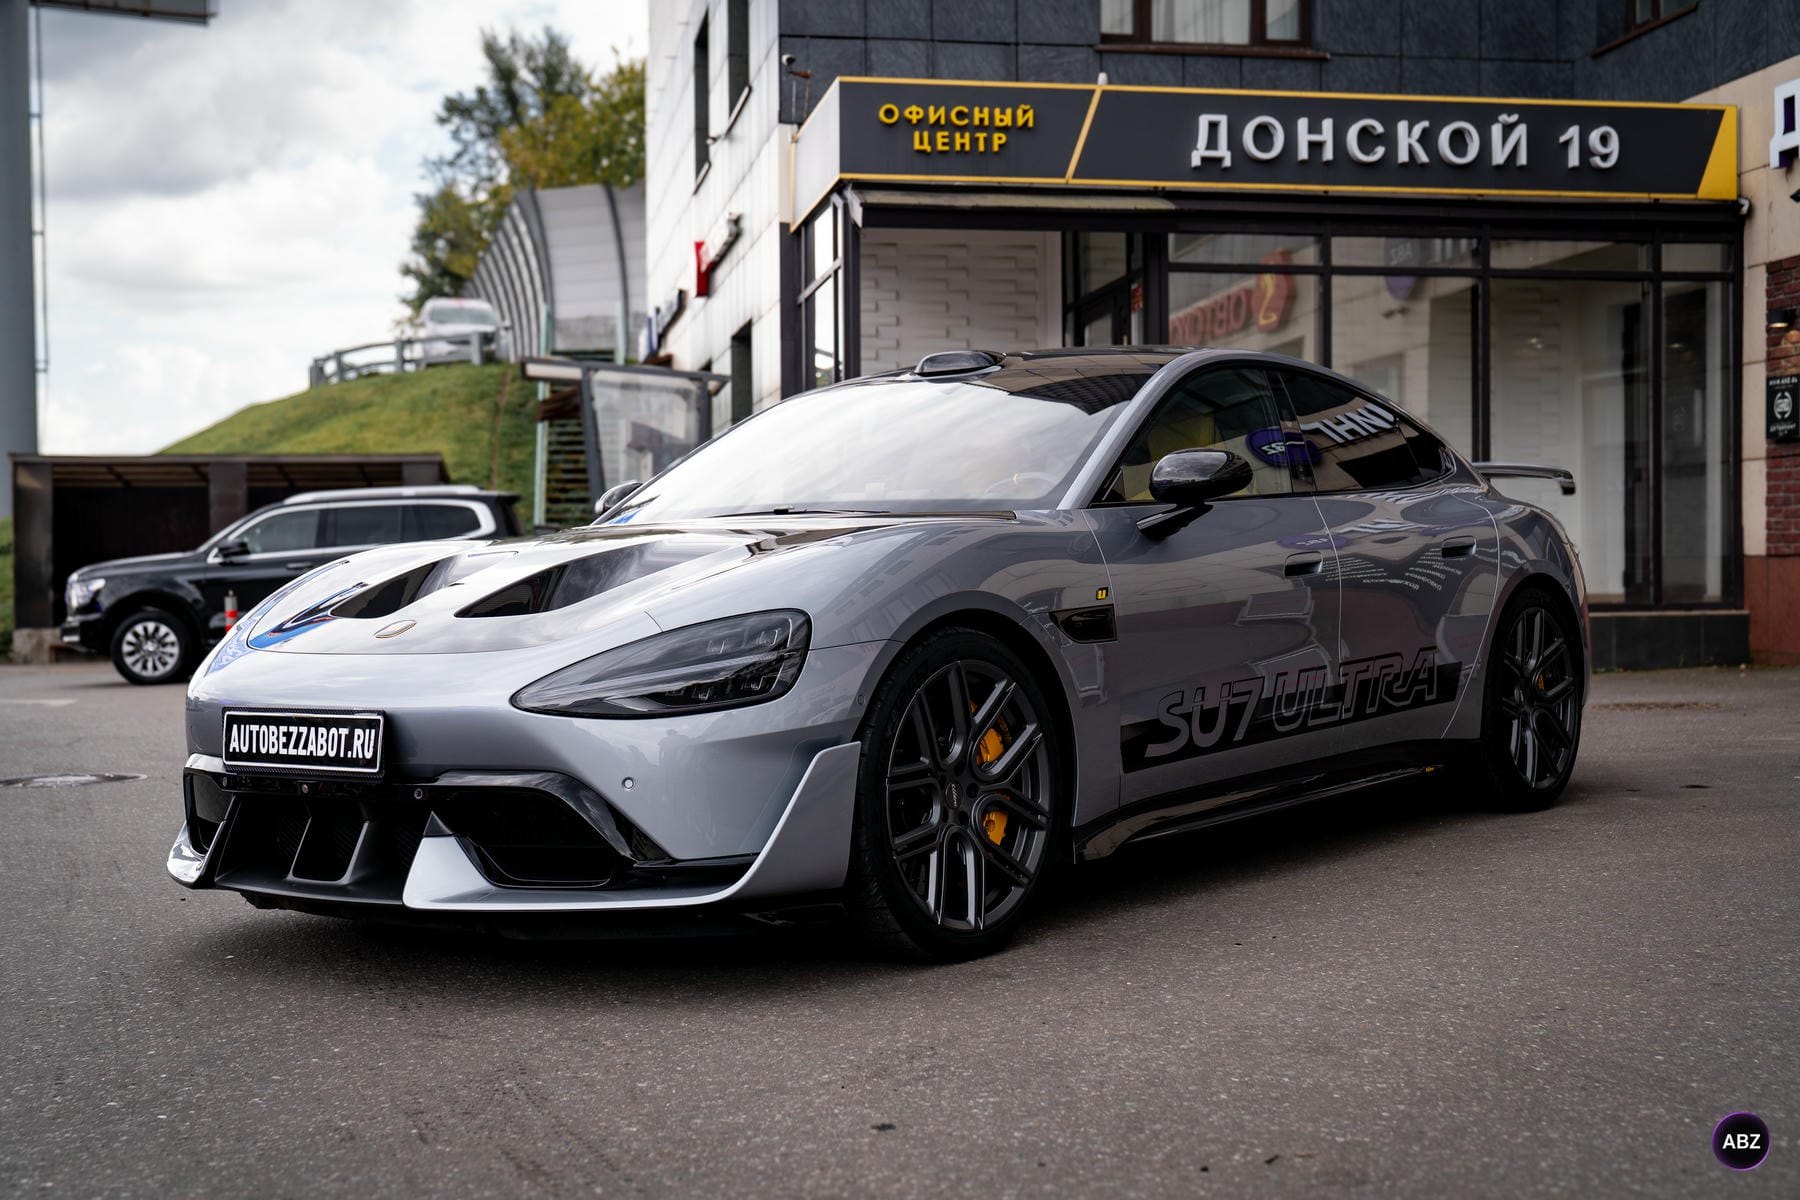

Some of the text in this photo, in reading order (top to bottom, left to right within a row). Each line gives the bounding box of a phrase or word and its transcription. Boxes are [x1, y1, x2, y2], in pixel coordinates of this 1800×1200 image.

[878, 103, 1034, 128] ОФИСНЫЙ
[913, 130, 1007, 153] ЦЕНТР
[1191, 113, 1620, 169] ДОНСКОЙ 19
[1144, 645, 1438, 758] SU7 ULTRA
[229, 724, 375, 759] AUTOBEZZABOT.RU
